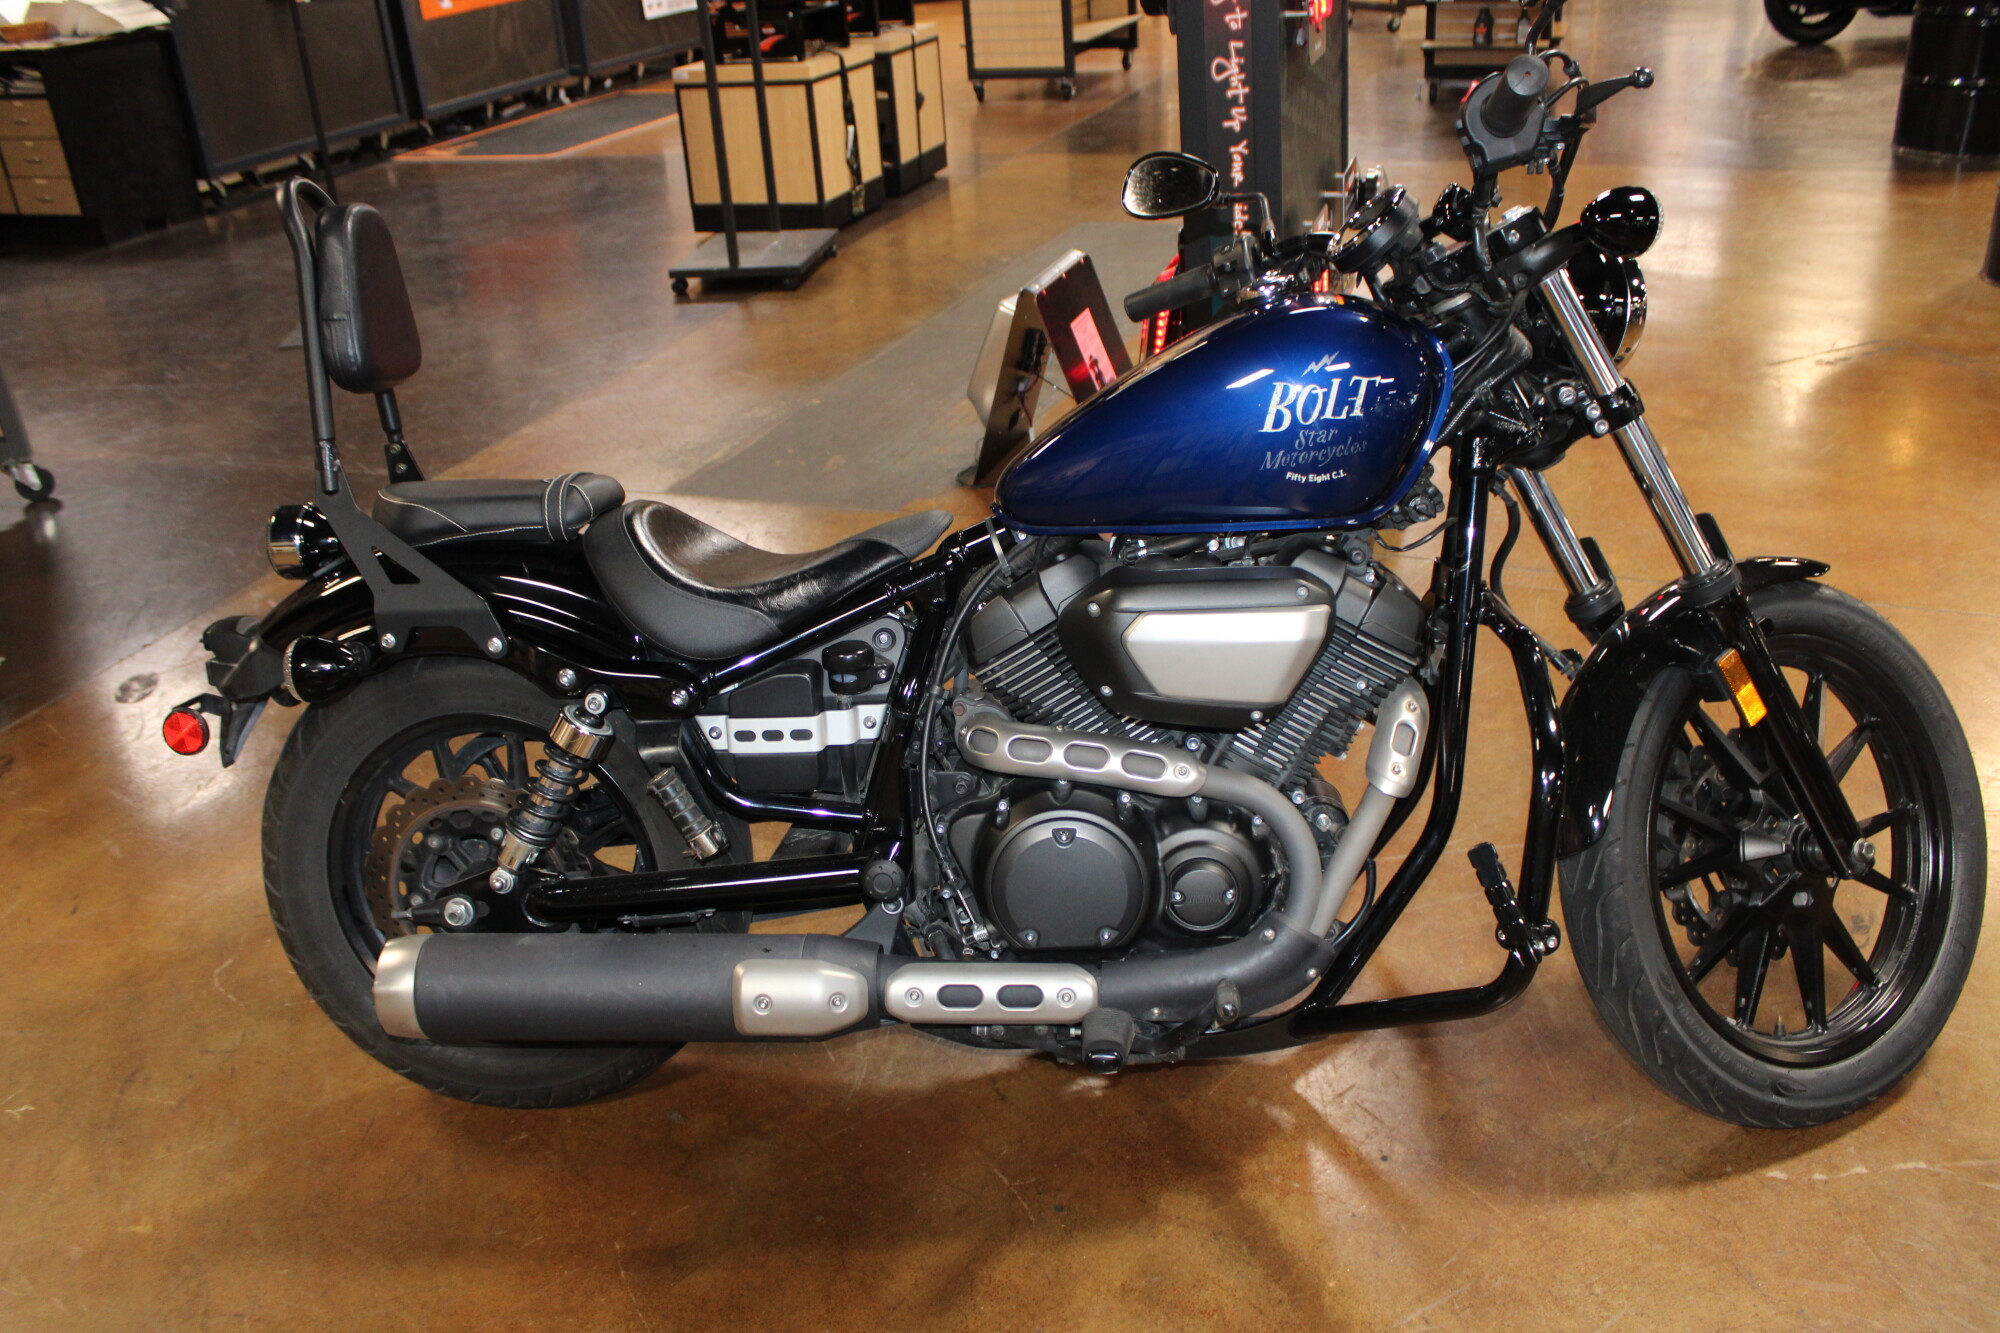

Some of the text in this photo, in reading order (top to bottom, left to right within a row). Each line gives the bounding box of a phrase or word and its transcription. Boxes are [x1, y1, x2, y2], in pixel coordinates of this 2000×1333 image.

[1223, 5, 1249, 31] to
[1211, 40, 1250, 104] Light
[1222, 106, 1248, 133] Up
[1228, 138, 1249, 188] Your
[1258, 375, 1382, 433] BOLT
[1259, 436, 1368, 471] Motorcycles
[1294, 427, 1338, 450] Star
[1285, 468, 1348, 483] Fifty Eight C.I.
